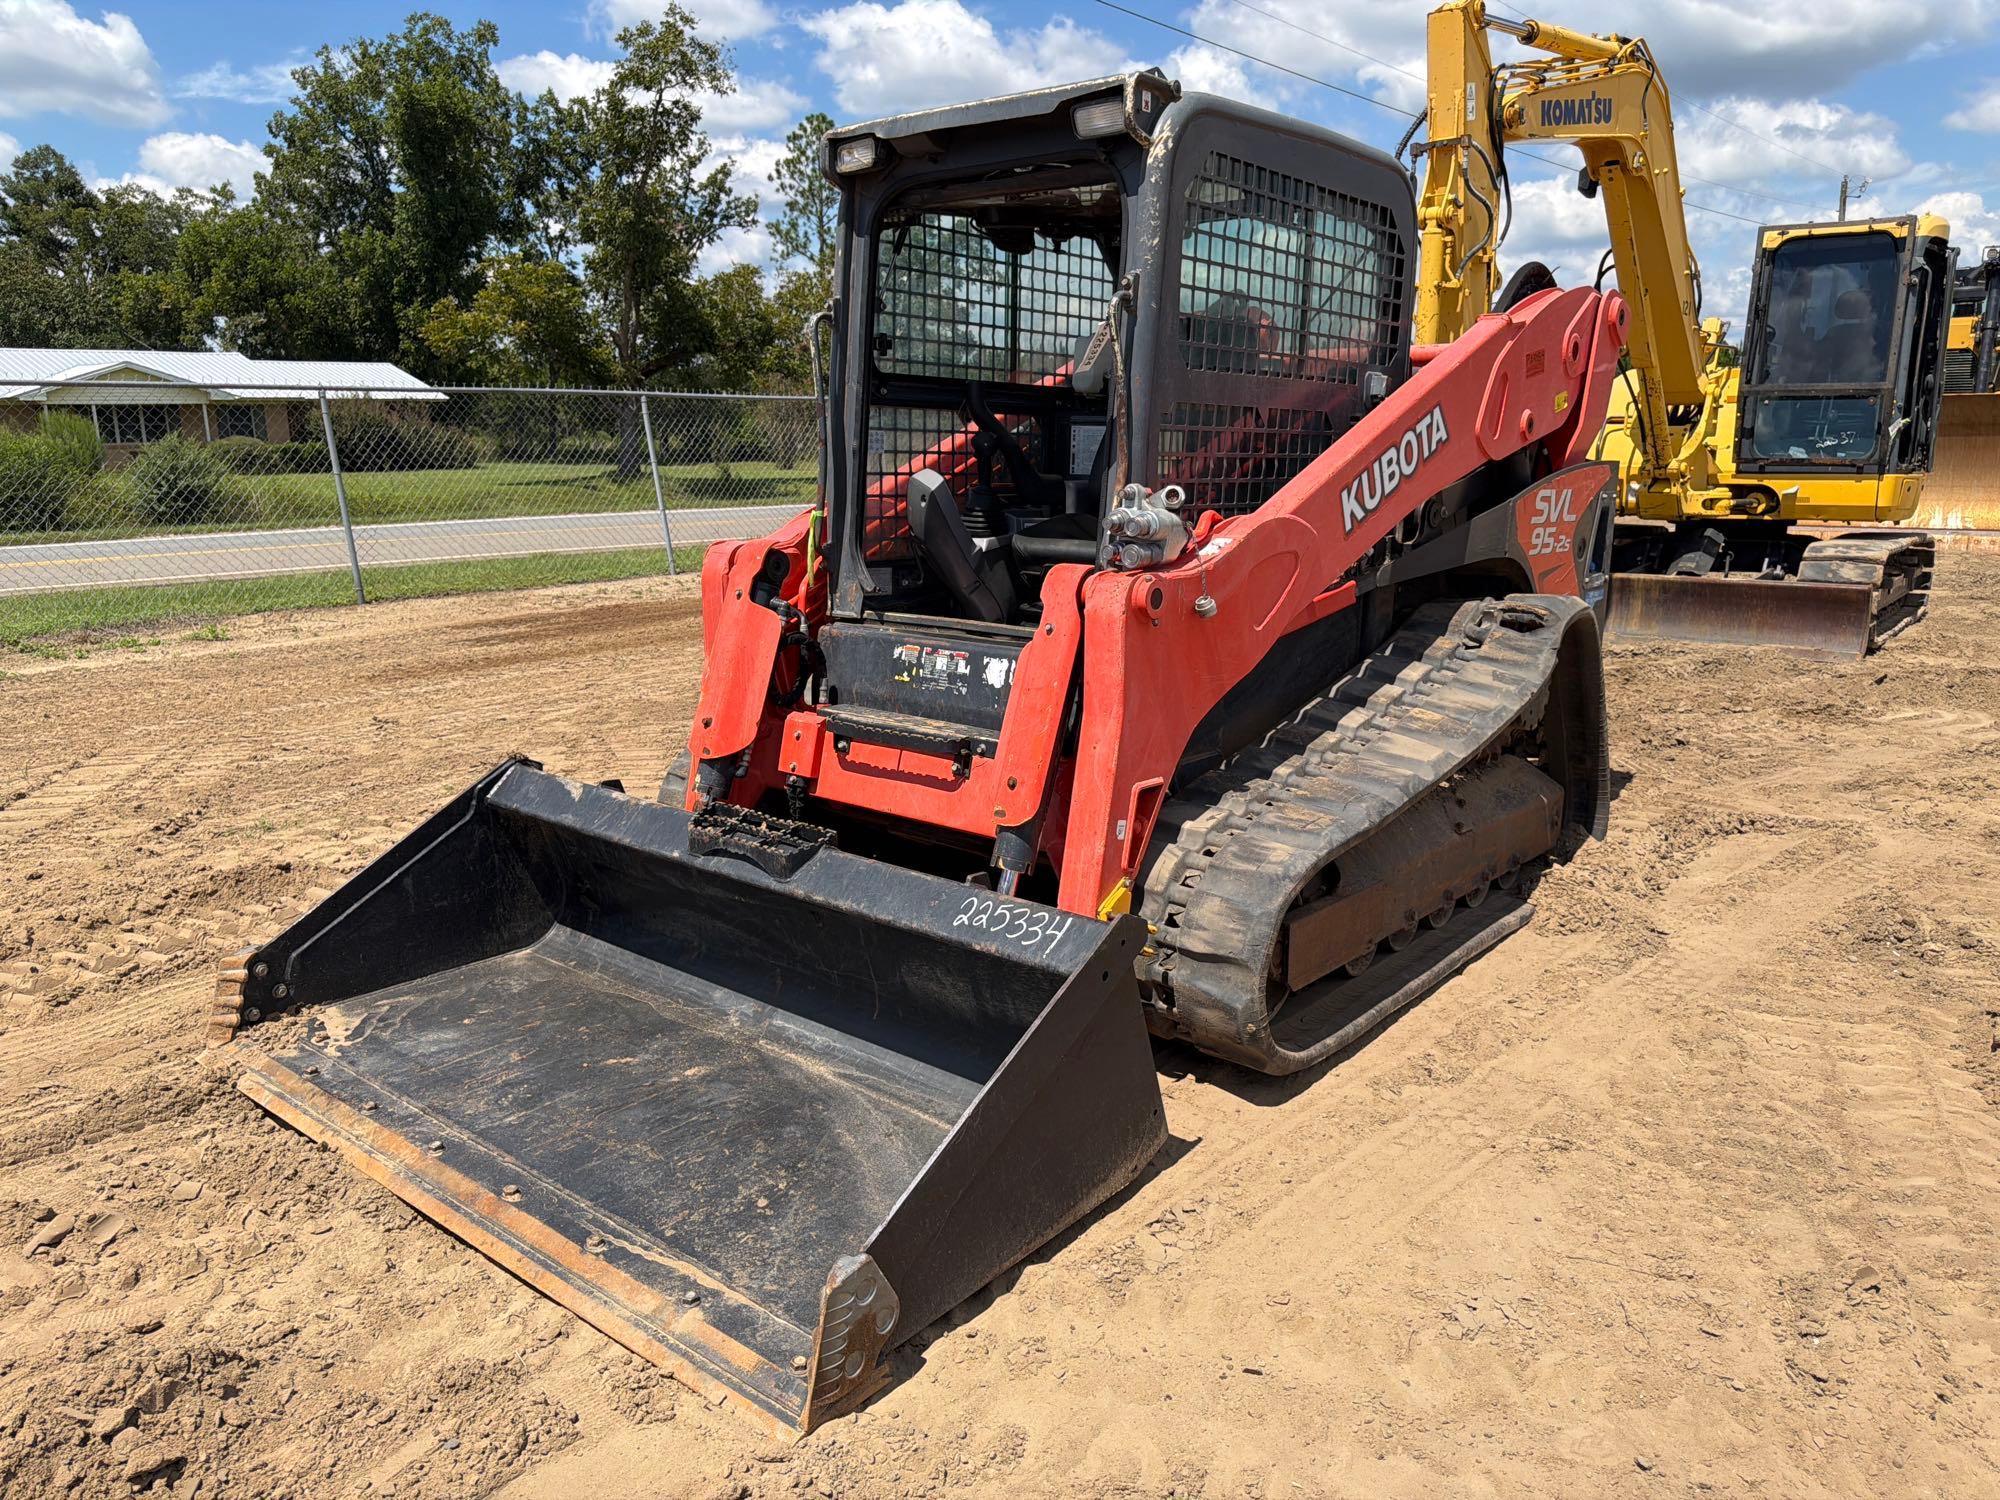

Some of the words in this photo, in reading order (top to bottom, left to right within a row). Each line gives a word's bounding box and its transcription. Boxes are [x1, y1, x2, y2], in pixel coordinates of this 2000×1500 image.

[1541, 91, 1612, 126] KOMATSU
[1341, 405, 1448, 532] KUBOTA
[1531, 489, 1576, 524] SVL
[953, 896, 1073, 958] 225334
